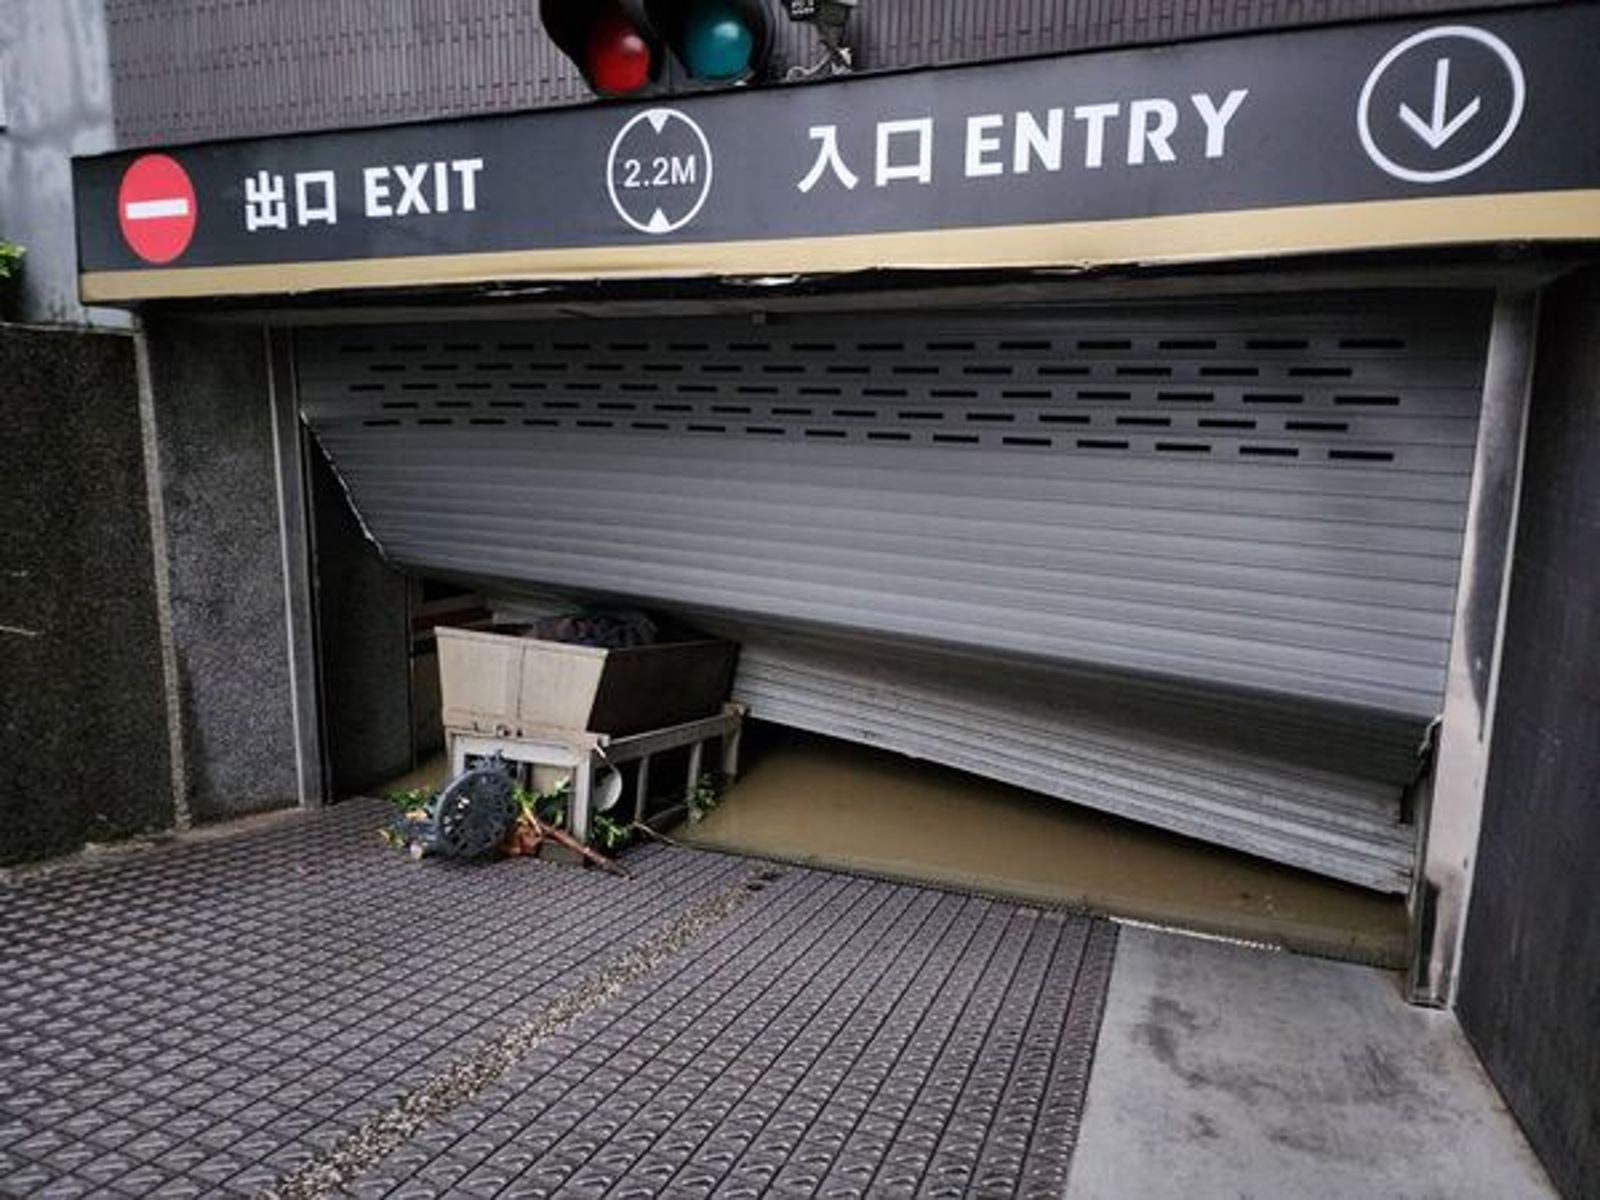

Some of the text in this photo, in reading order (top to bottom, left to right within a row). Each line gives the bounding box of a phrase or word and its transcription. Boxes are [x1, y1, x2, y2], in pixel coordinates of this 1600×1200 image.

[623, 154, 697, 189] 2.2M
[797, 88, 1249, 193] 入口 ENTRY
[244, 158, 484, 230] 出口 EXIT
